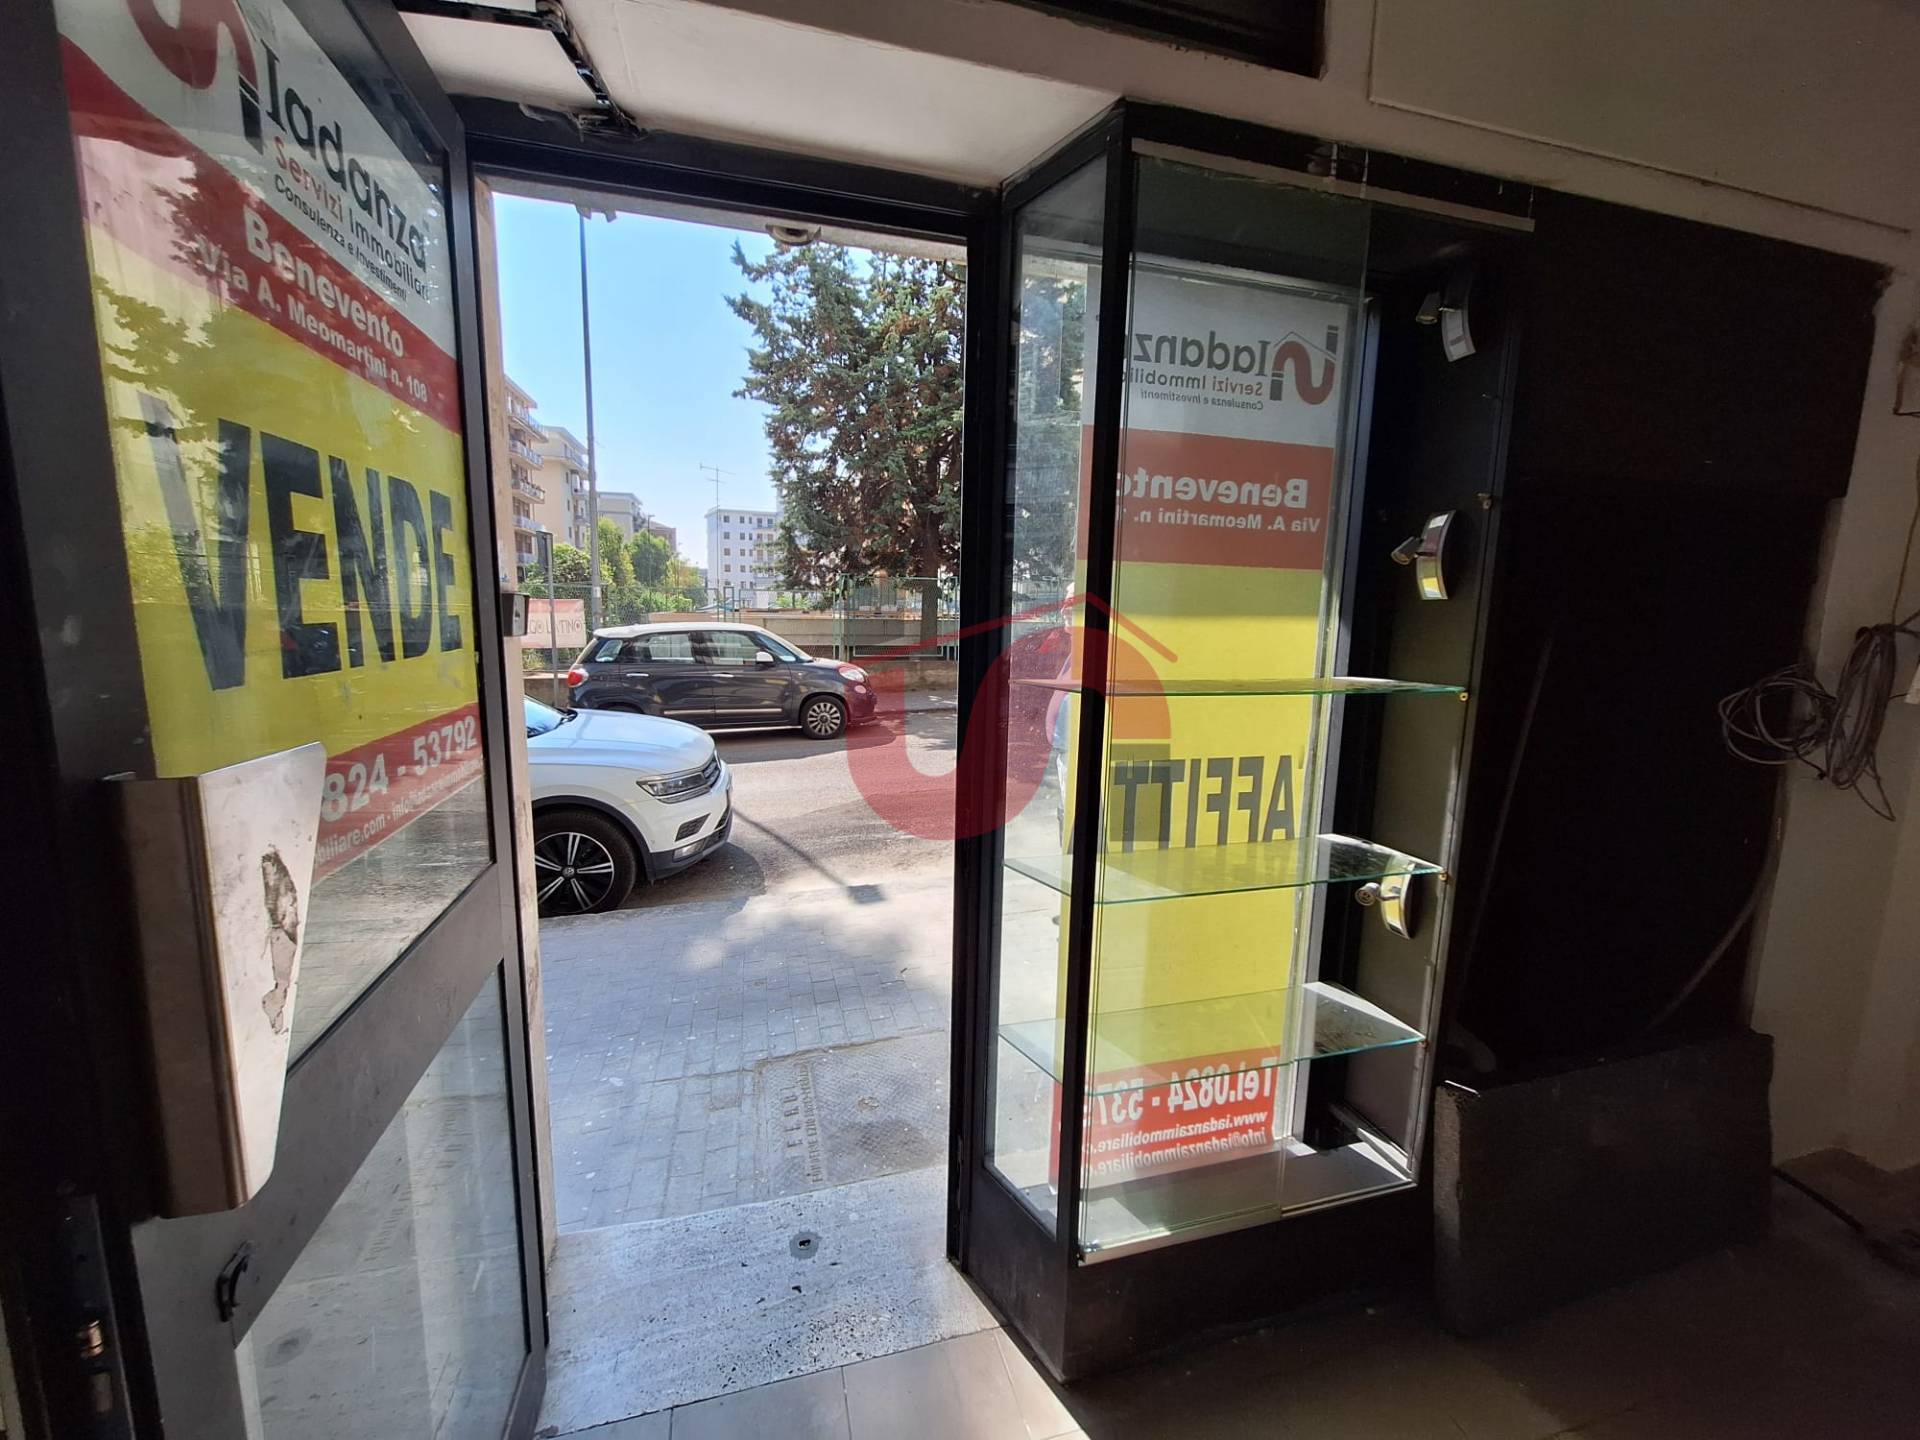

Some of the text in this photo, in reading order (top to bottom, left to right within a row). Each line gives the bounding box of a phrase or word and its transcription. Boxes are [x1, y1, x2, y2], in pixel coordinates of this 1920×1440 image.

[260, 39, 428, 273] Iadanza
[274, 135, 344, 223] Servizi
[275, 174, 345, 247] Consulenza
[348, 242, 355, 256] e
[198, 233, 428, 402] Via A. Meomartini n. 108
[243, 204, 404, 358] Benevento
[137, 392, 463, 691] VENDE
[414, 715, 478, 776] 53792
